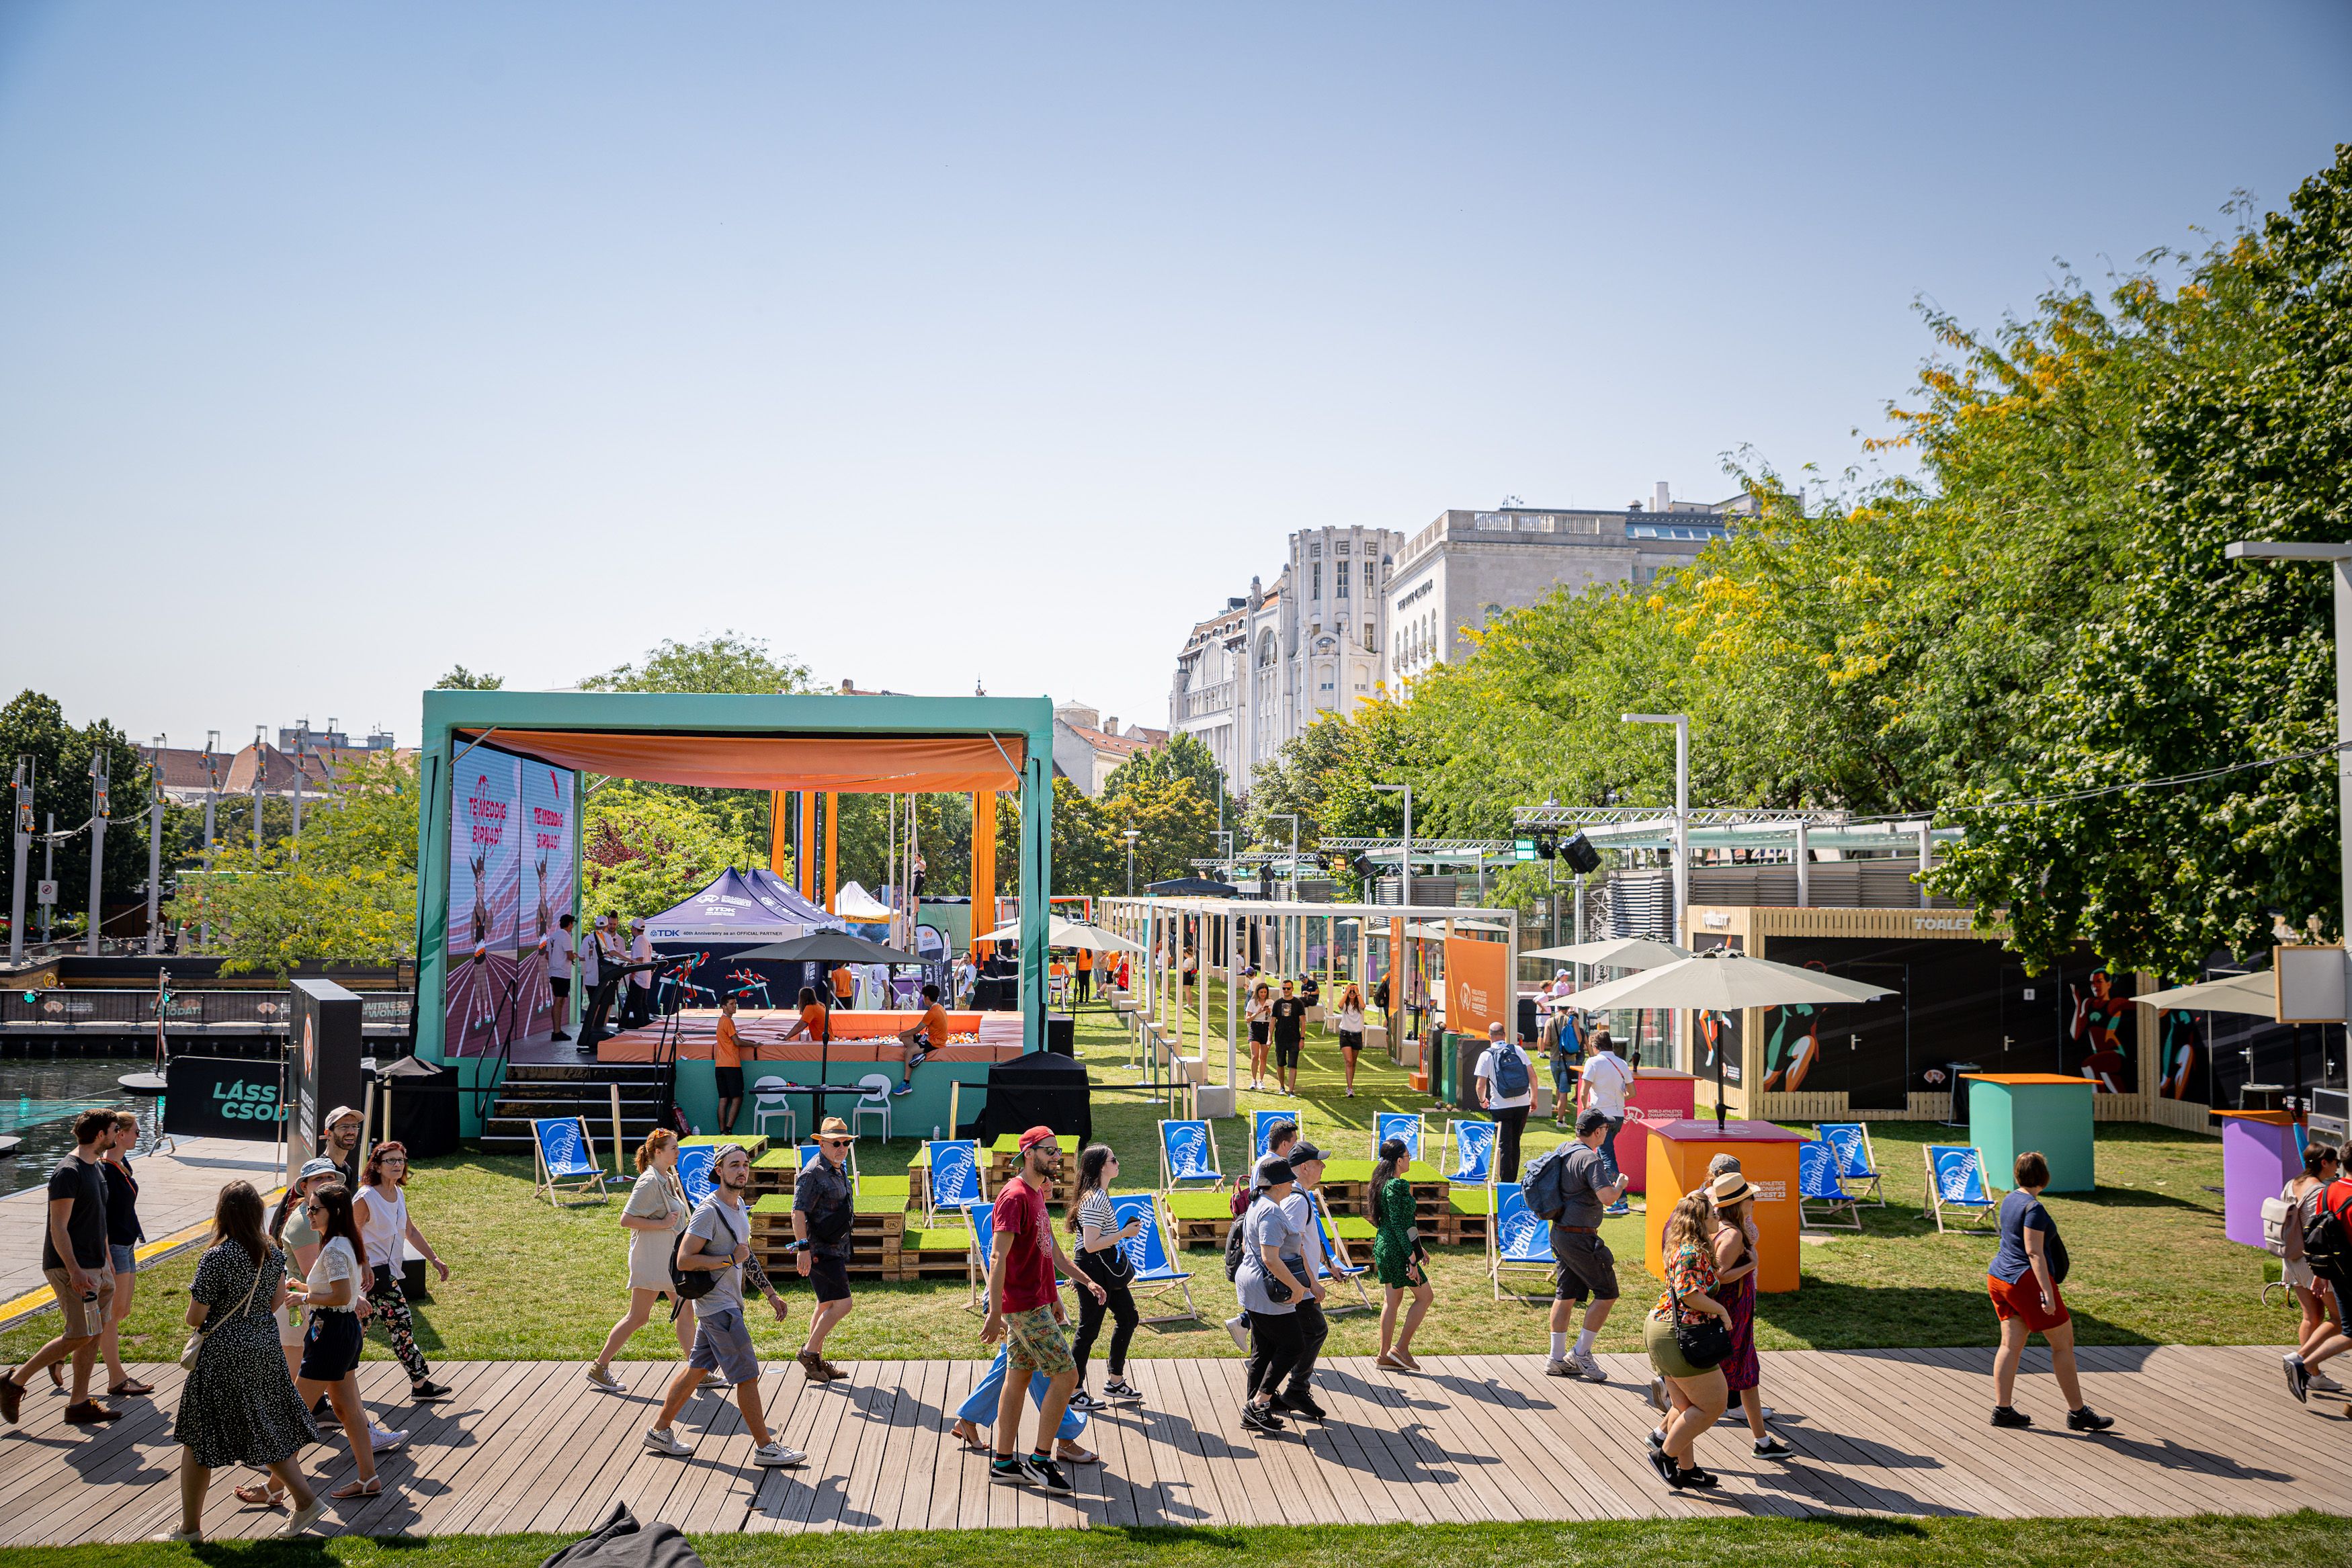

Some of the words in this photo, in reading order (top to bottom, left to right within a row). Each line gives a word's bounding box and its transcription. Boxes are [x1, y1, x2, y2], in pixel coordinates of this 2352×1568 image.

[469, 797, 478, 815] TE
[478, 799, 506, 820] MEDDIG
[534, 807, 542, 824] TE
[542, 809, 563, 828] MEDDIG
[1914, 918, 1974, 930] TOALET
[363, 1001, 409, 1010] WITNESS
[212, 1079, 278, 1102] LÁSS
